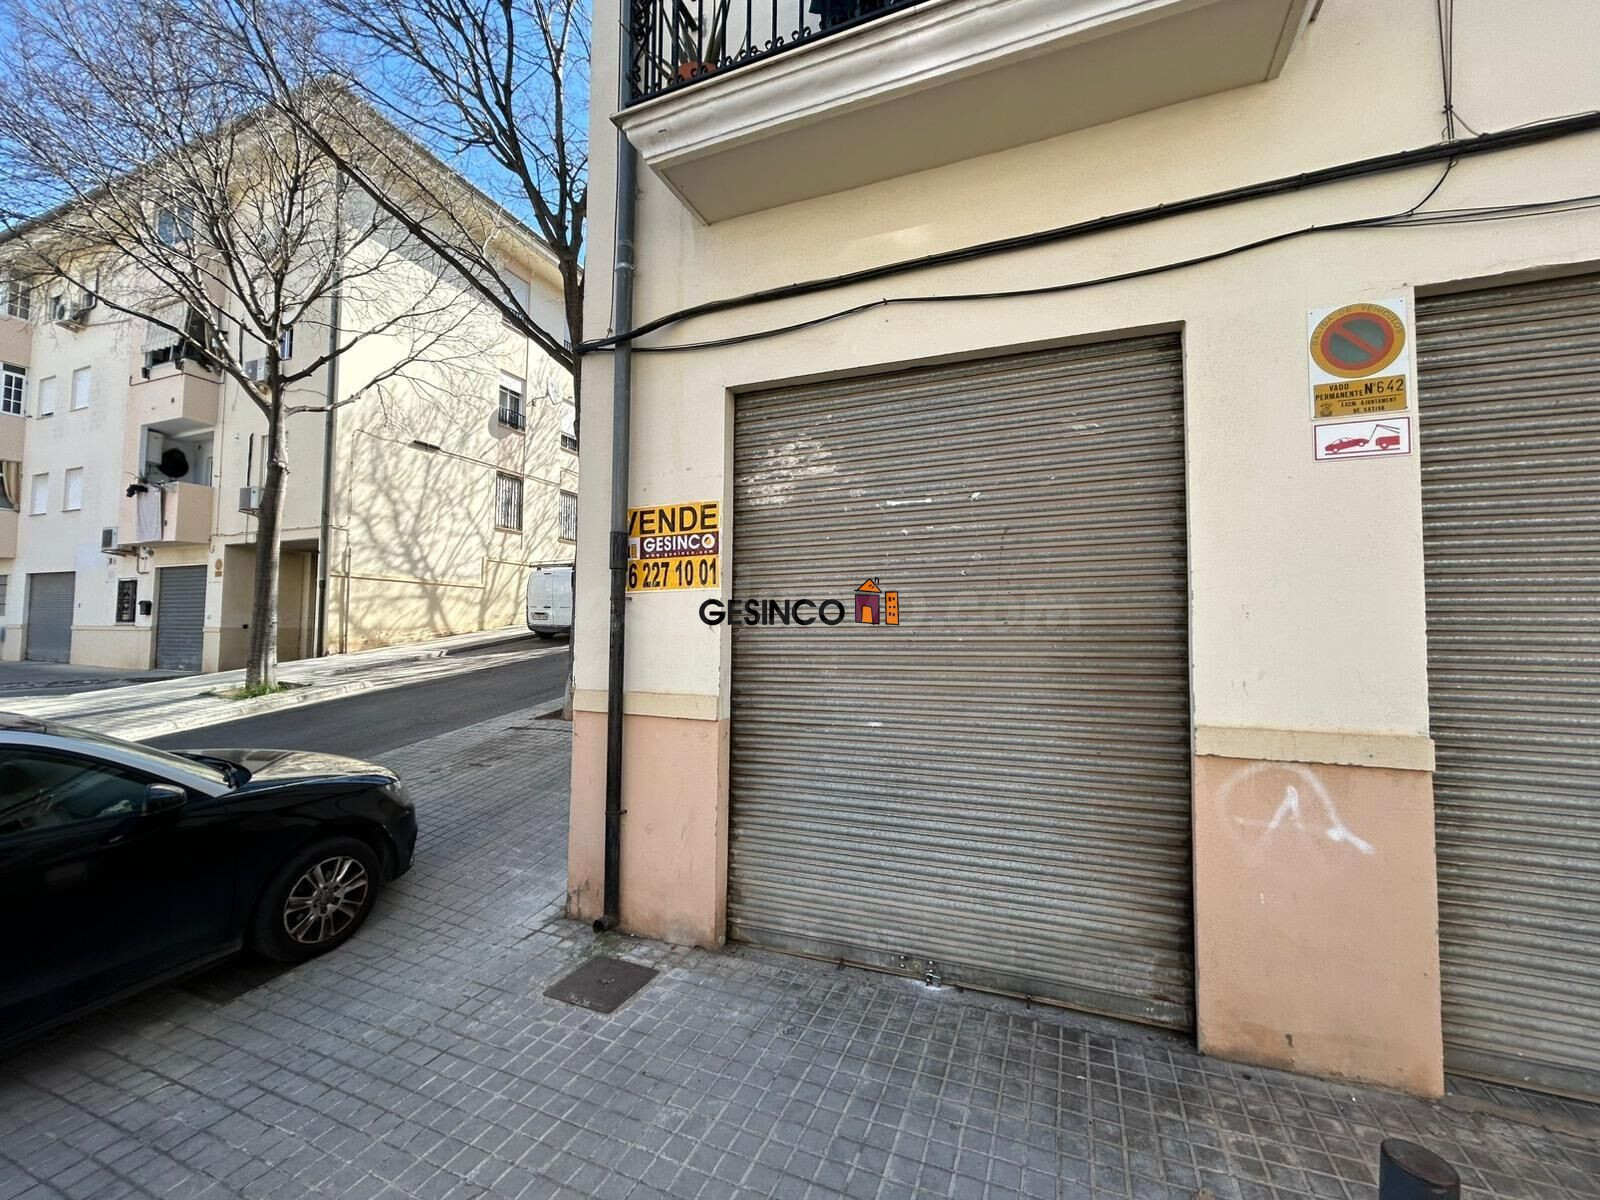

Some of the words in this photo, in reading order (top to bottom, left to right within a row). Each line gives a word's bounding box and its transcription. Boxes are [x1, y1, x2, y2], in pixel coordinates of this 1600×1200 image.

[1315, 389, 1364, 401] PERMANENTE
[1329, 383, 1349, 392] VADO
[643, 533, 716, 553] GESINCO
[642, 561, 670, 588] 227
[675, 559, 694, 586] 10
[698, 558, 717, 585] 01
